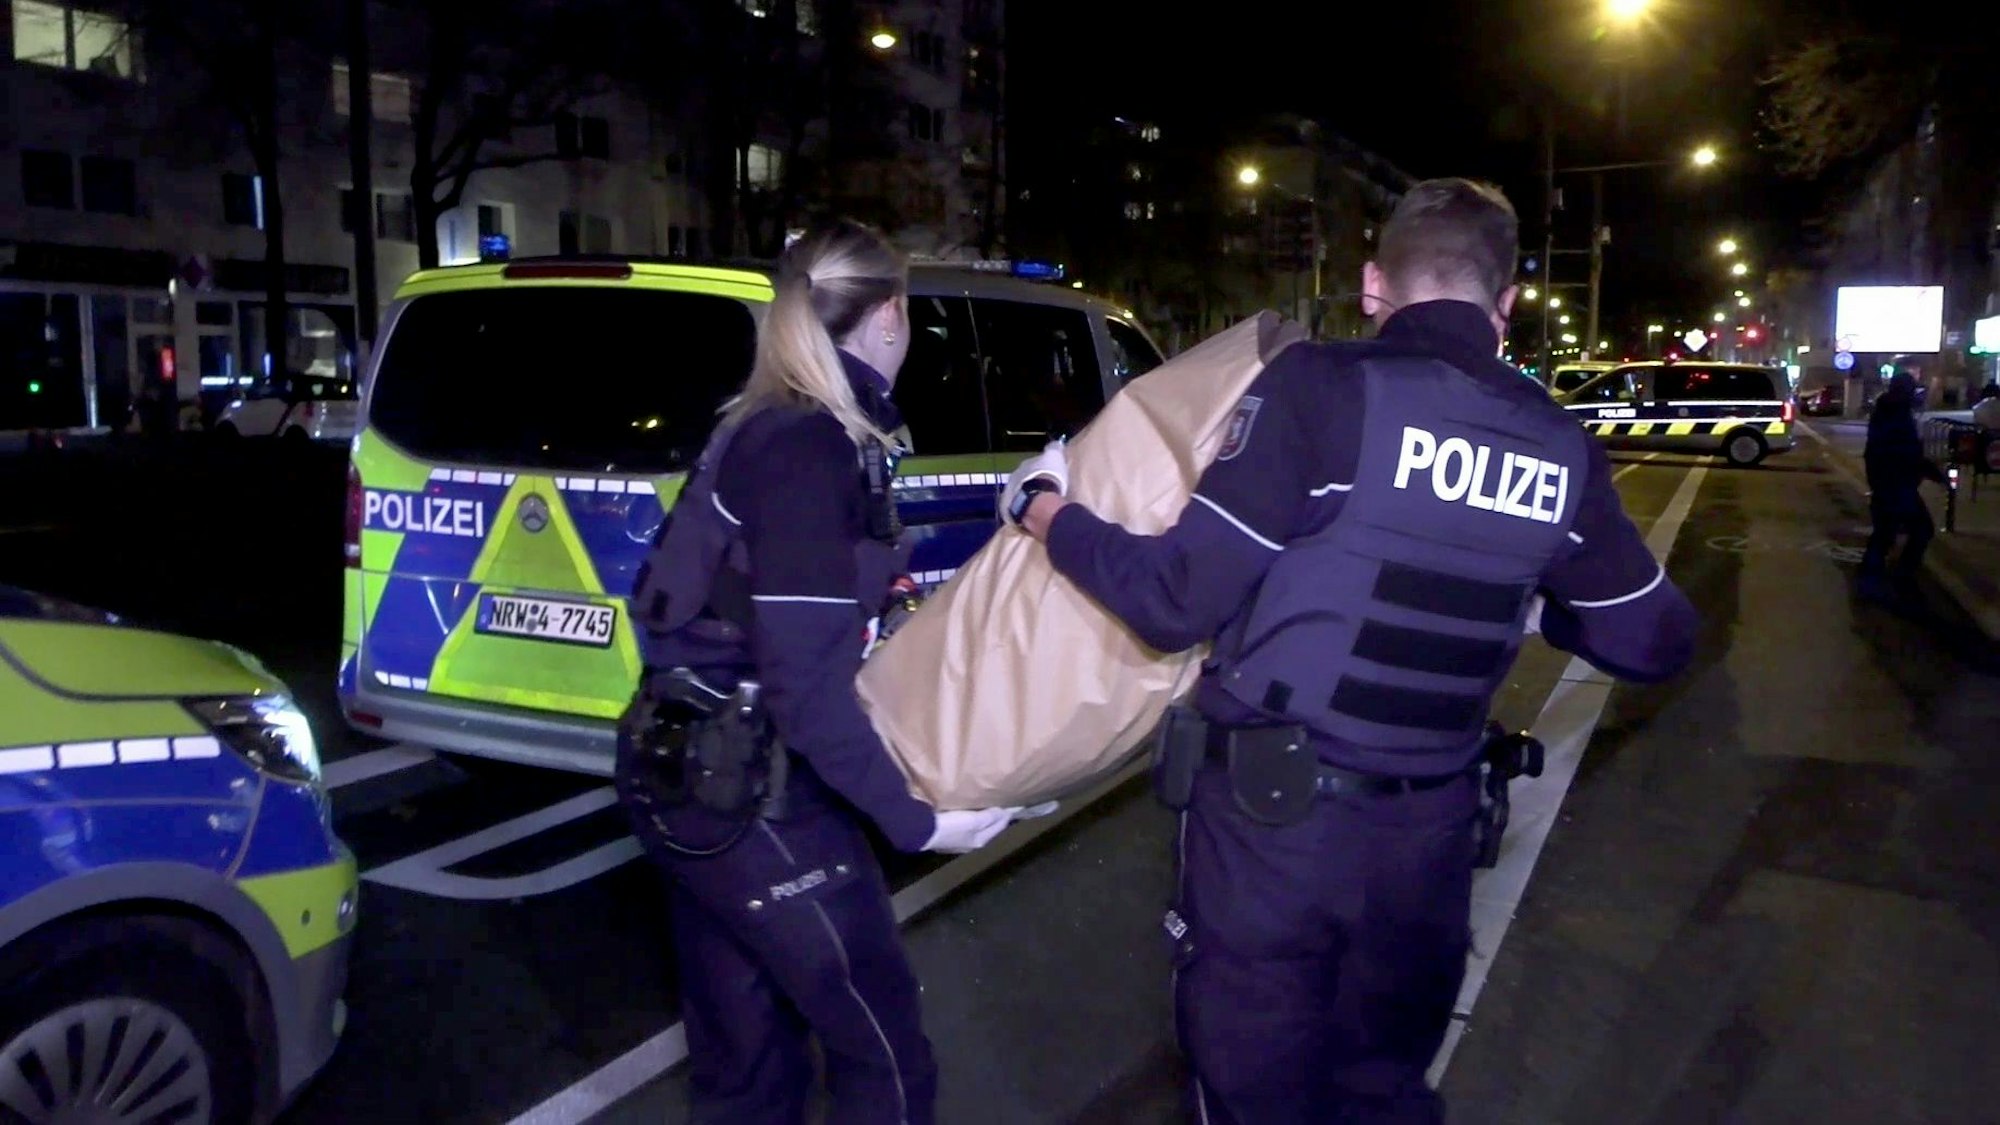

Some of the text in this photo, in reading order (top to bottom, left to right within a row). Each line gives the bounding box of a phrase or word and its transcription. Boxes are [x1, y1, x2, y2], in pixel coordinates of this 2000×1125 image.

[1393, 426, 1569, 524] POLIZEI
[364, 490, 484, 538] POLIZEI
[490, 600, 611, 638] NRW 4-7745
